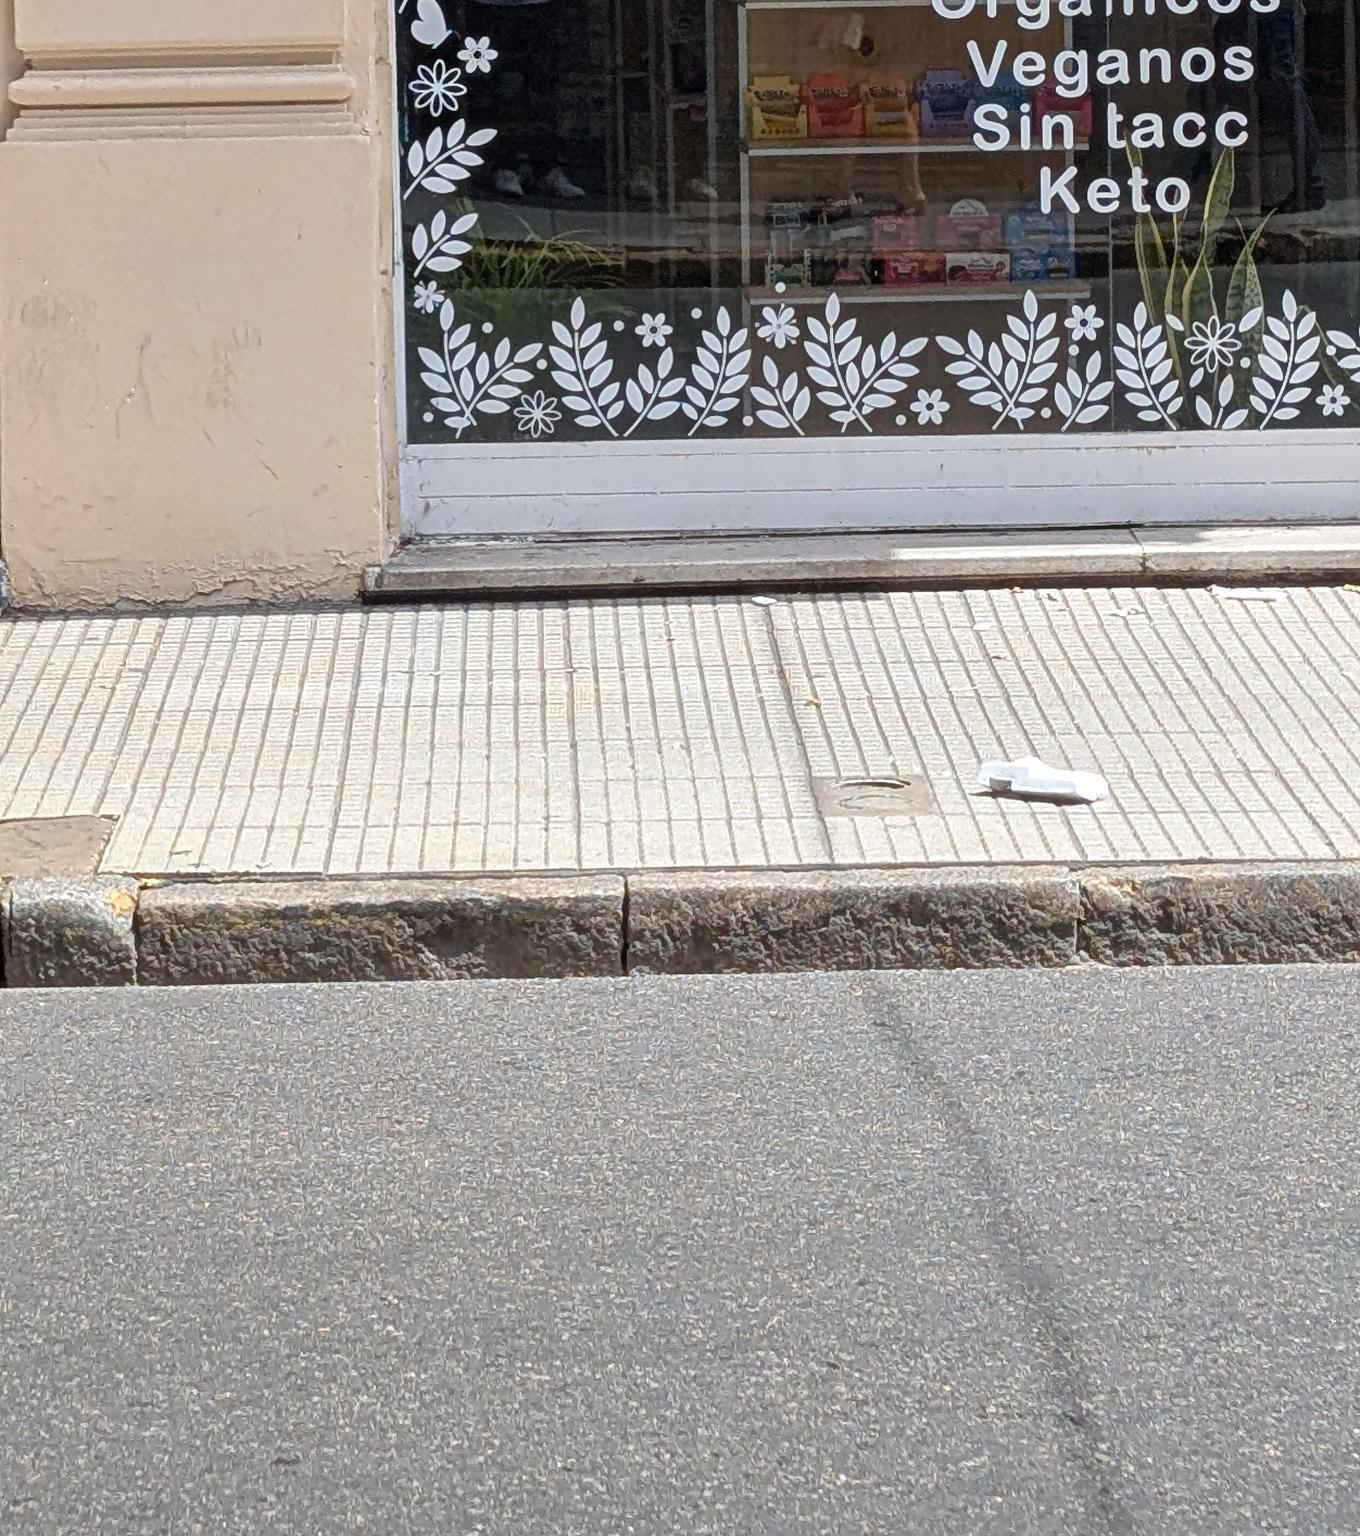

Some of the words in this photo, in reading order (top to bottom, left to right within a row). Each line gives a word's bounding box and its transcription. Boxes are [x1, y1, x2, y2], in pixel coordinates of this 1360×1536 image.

[966, 39, 1254, 98] Veganos
[972, 102, 1074, 152] Sin
[1107, 103, 1249, 149] tacc
[1040, 166, 1192, 215] Keto
